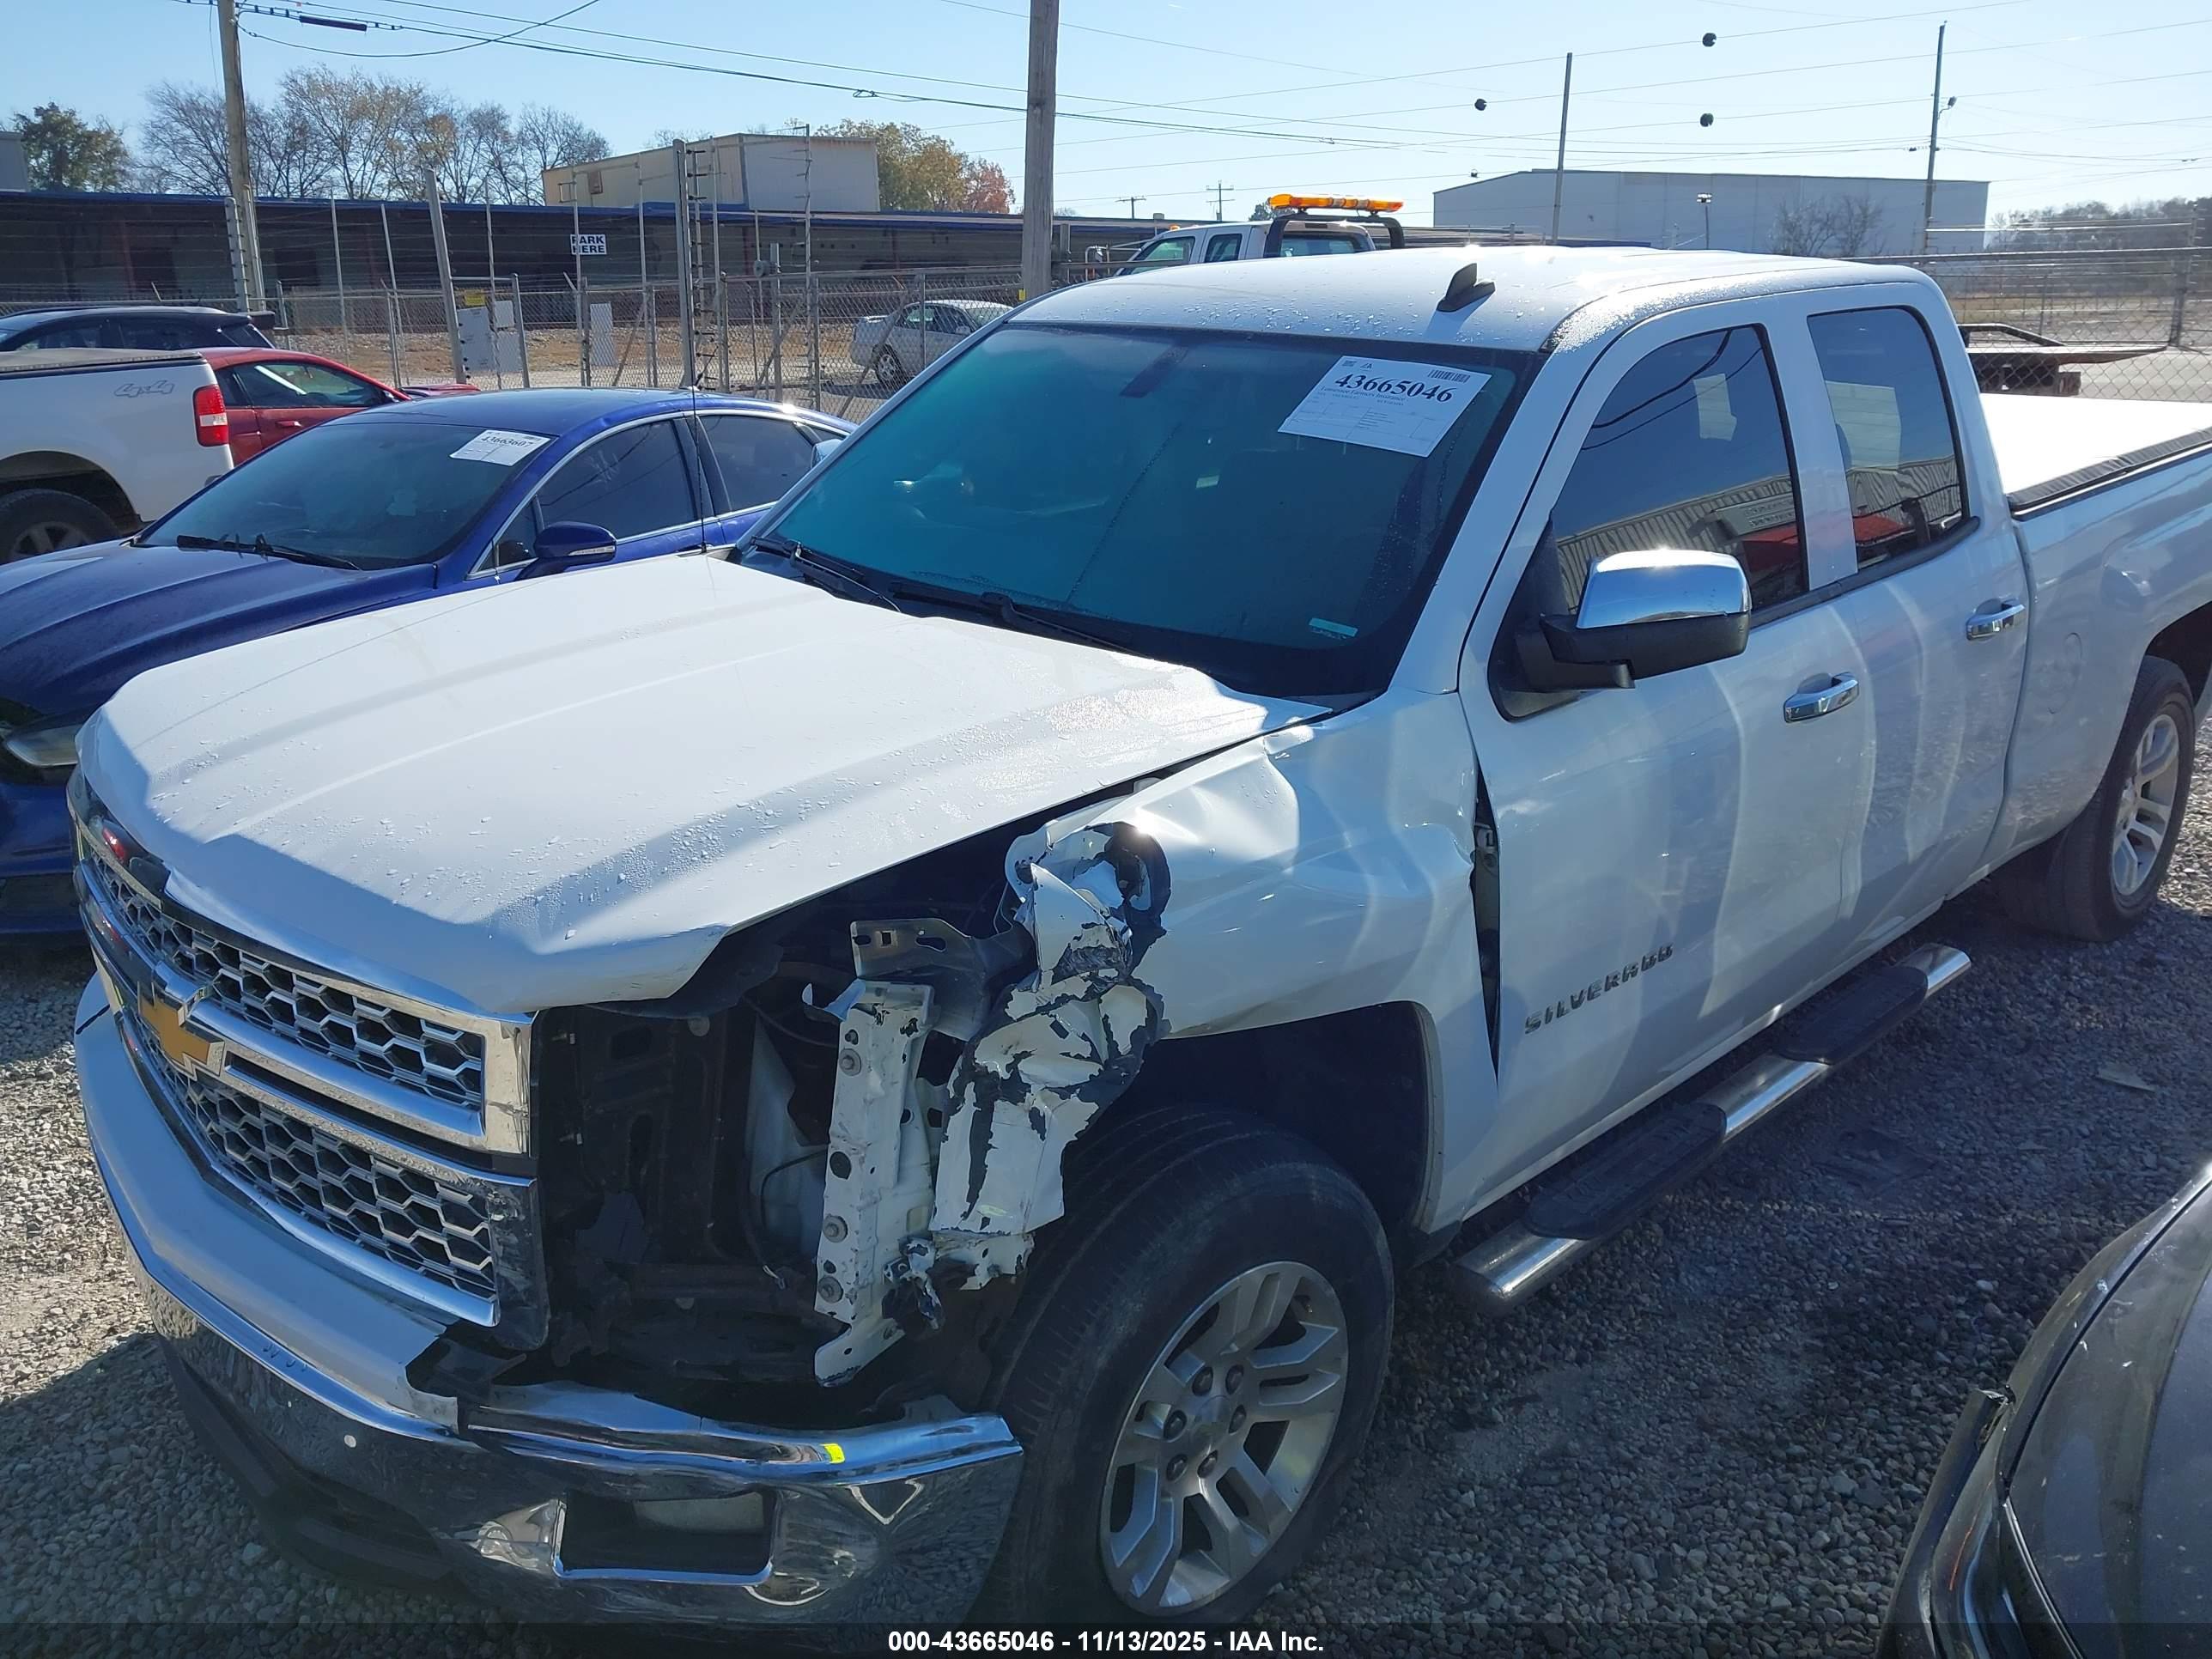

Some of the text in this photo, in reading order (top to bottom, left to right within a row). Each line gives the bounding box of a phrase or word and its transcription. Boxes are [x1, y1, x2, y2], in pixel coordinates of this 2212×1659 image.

[572, 236, 605, 245] PARK
[573, 245, 605, 253] HERE
[1335, 374, 1457, 403] 43665046
[1525, 943, 1674, 1035] SILVERADO
